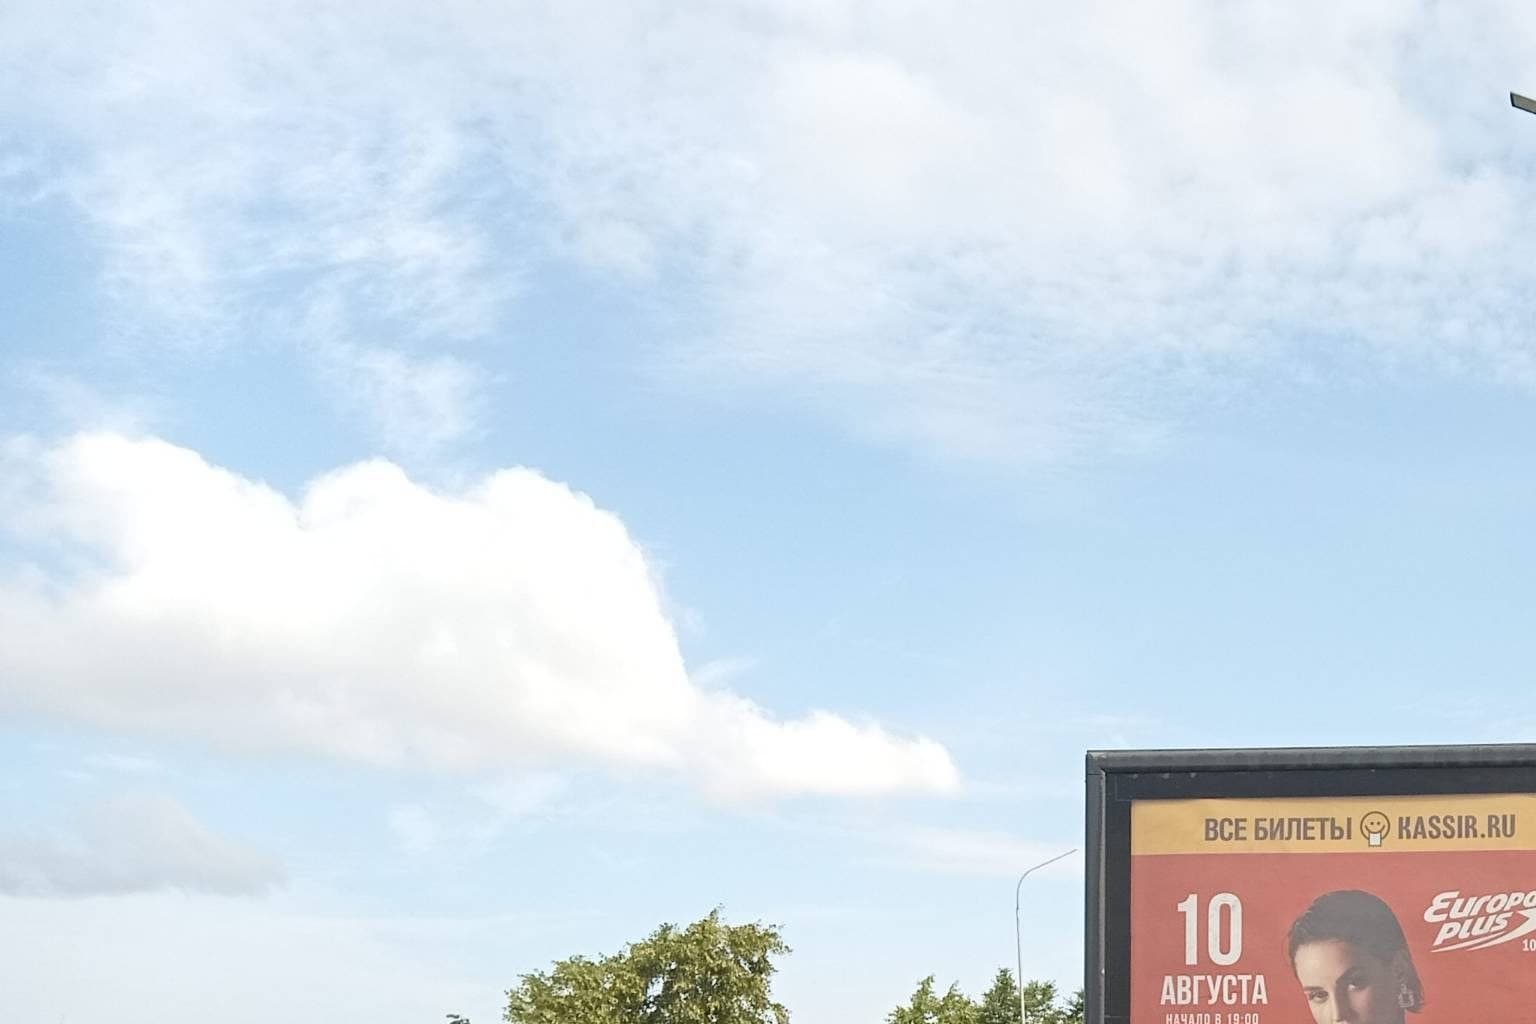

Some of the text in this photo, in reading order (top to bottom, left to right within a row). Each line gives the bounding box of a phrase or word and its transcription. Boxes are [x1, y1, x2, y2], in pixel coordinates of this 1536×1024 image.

[1204, 817, 1352, 842] ВСЕ БИЛЕТЫ
[1399, 814, 1516, 839] KASSIR.RU
[1177, 893, 1242, 966] 10
[1160, 975, 1268, 1005] АВГУСТА
